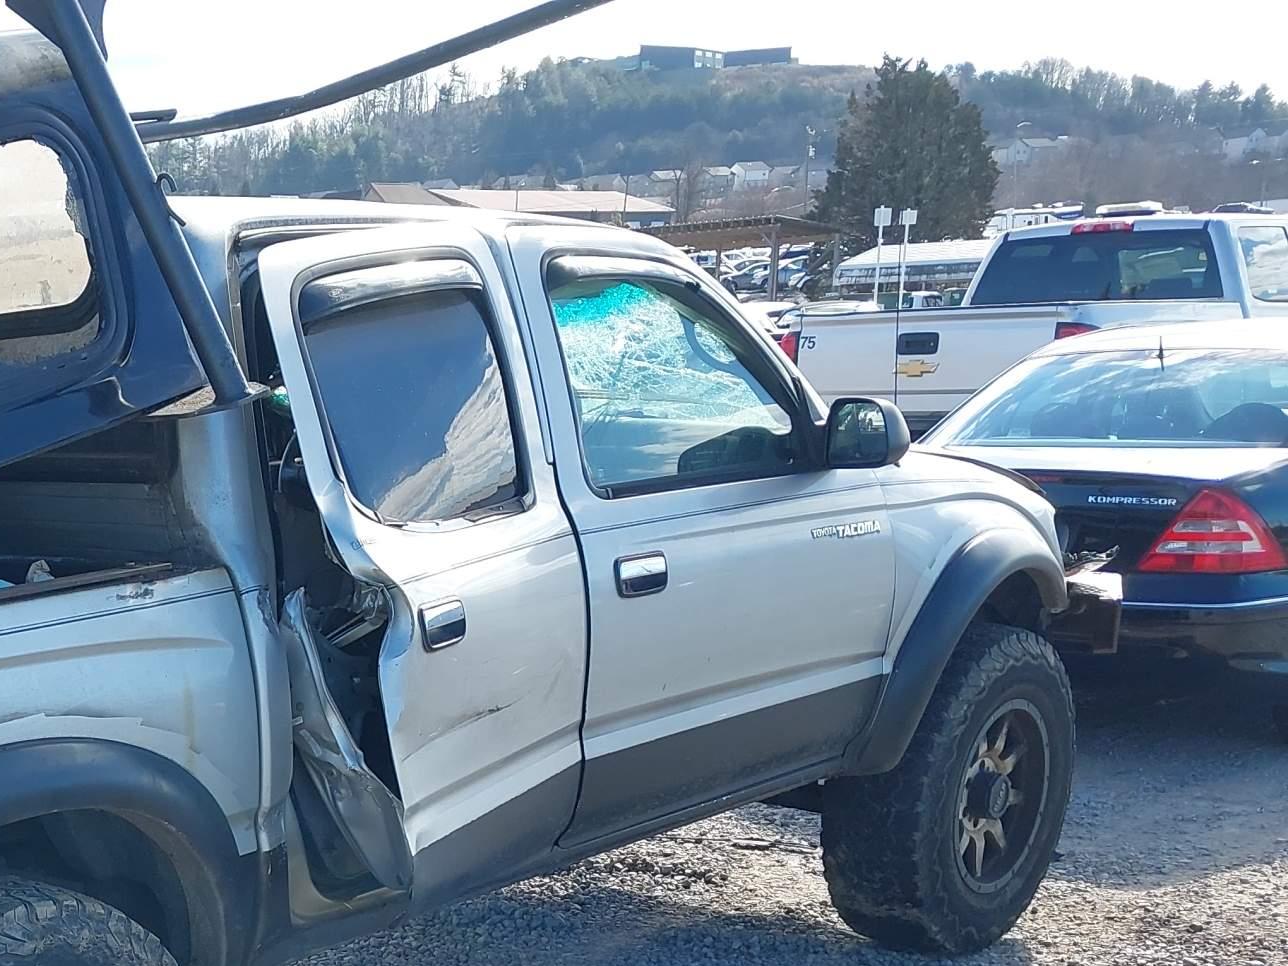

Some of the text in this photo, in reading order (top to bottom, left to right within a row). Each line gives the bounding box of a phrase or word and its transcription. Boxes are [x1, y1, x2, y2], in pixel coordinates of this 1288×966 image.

[800, 335, 817, 350] 75
[1088, 495, 1177, 506] KOMPRESSOR
[811, 520, 881, 539] TOYOTA TACOMA
